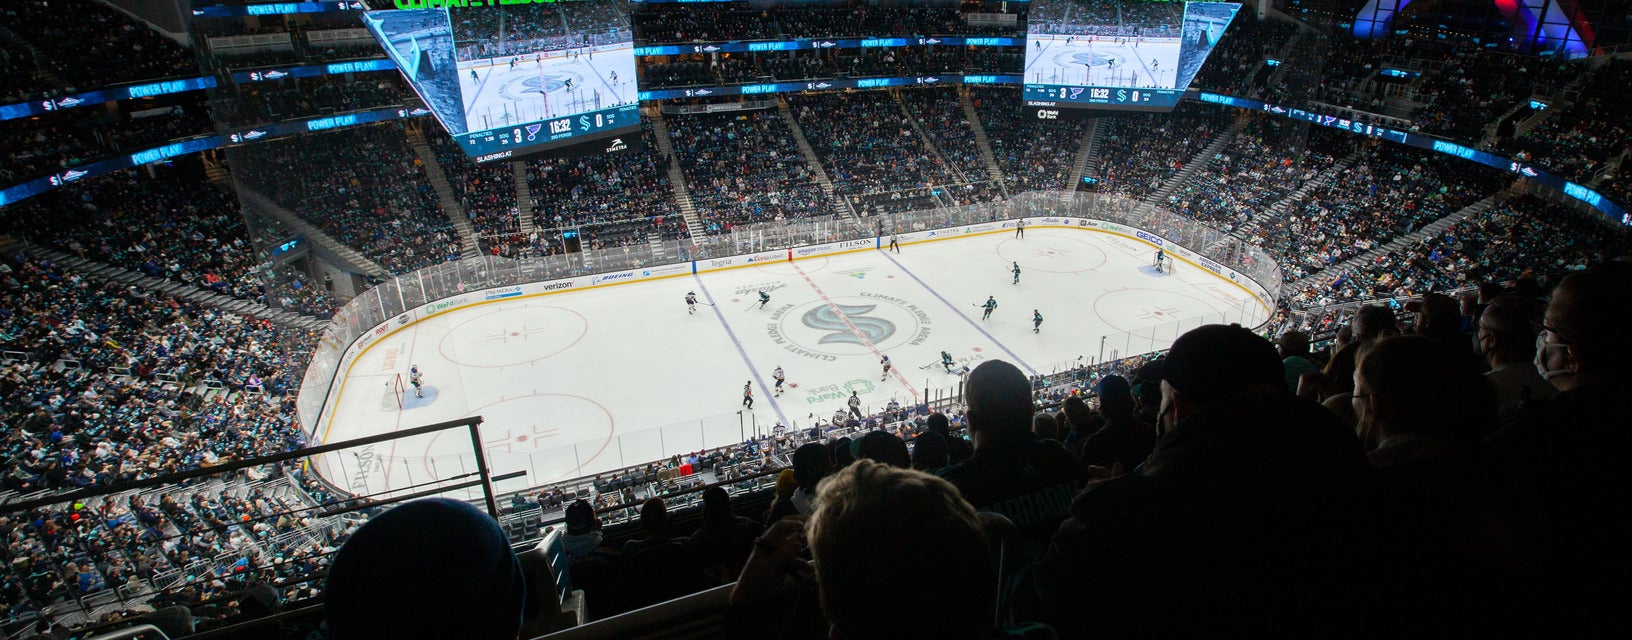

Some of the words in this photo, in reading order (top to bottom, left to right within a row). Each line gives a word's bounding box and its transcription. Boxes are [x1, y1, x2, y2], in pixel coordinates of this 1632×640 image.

[248, 5, 275, 15] POWER
[275, 4, 297, 14] PLAY
[328, 63, 354, 74] POWER
[354, 61, 377, 72] PLAY
[129, 83, 161, 98] POWER
[161, 80, 185, 94] PLAY
[1060, 87, 1067, 98] 3
[1091, 88, 1109, 99] 16:32
[1132, 90, 1139, 102] 0
[308, 118, 334, 131] POWER
[334, 115, 356, 128] PLAY
[513, 128, 522, 144] 3
[549, 119, 571, 134] 16:32
[595, 113, 603, 128] 0
[131, 148, 160, 166] POWER
[160, 143, 182, 158] PLAY
[1434, 140, 1458, 155] POWER
[1458, 146, 1475, 159] PLAY
[476, 151, 505, 163] SLASHING
[839, 238, 872, 248] FILSON
[1136, 230, 1163, 246] GEICO
[711, 258, 732, 268] Tegria
[1199, 256, 1222, 270] AMERICAN
[601, 271, 634, 281] BOEING
[543, 281, 573, 291] verizon
[860, 292, 907, 305] CLIMATE
[784, 344, 837, 361] CLIMATE
